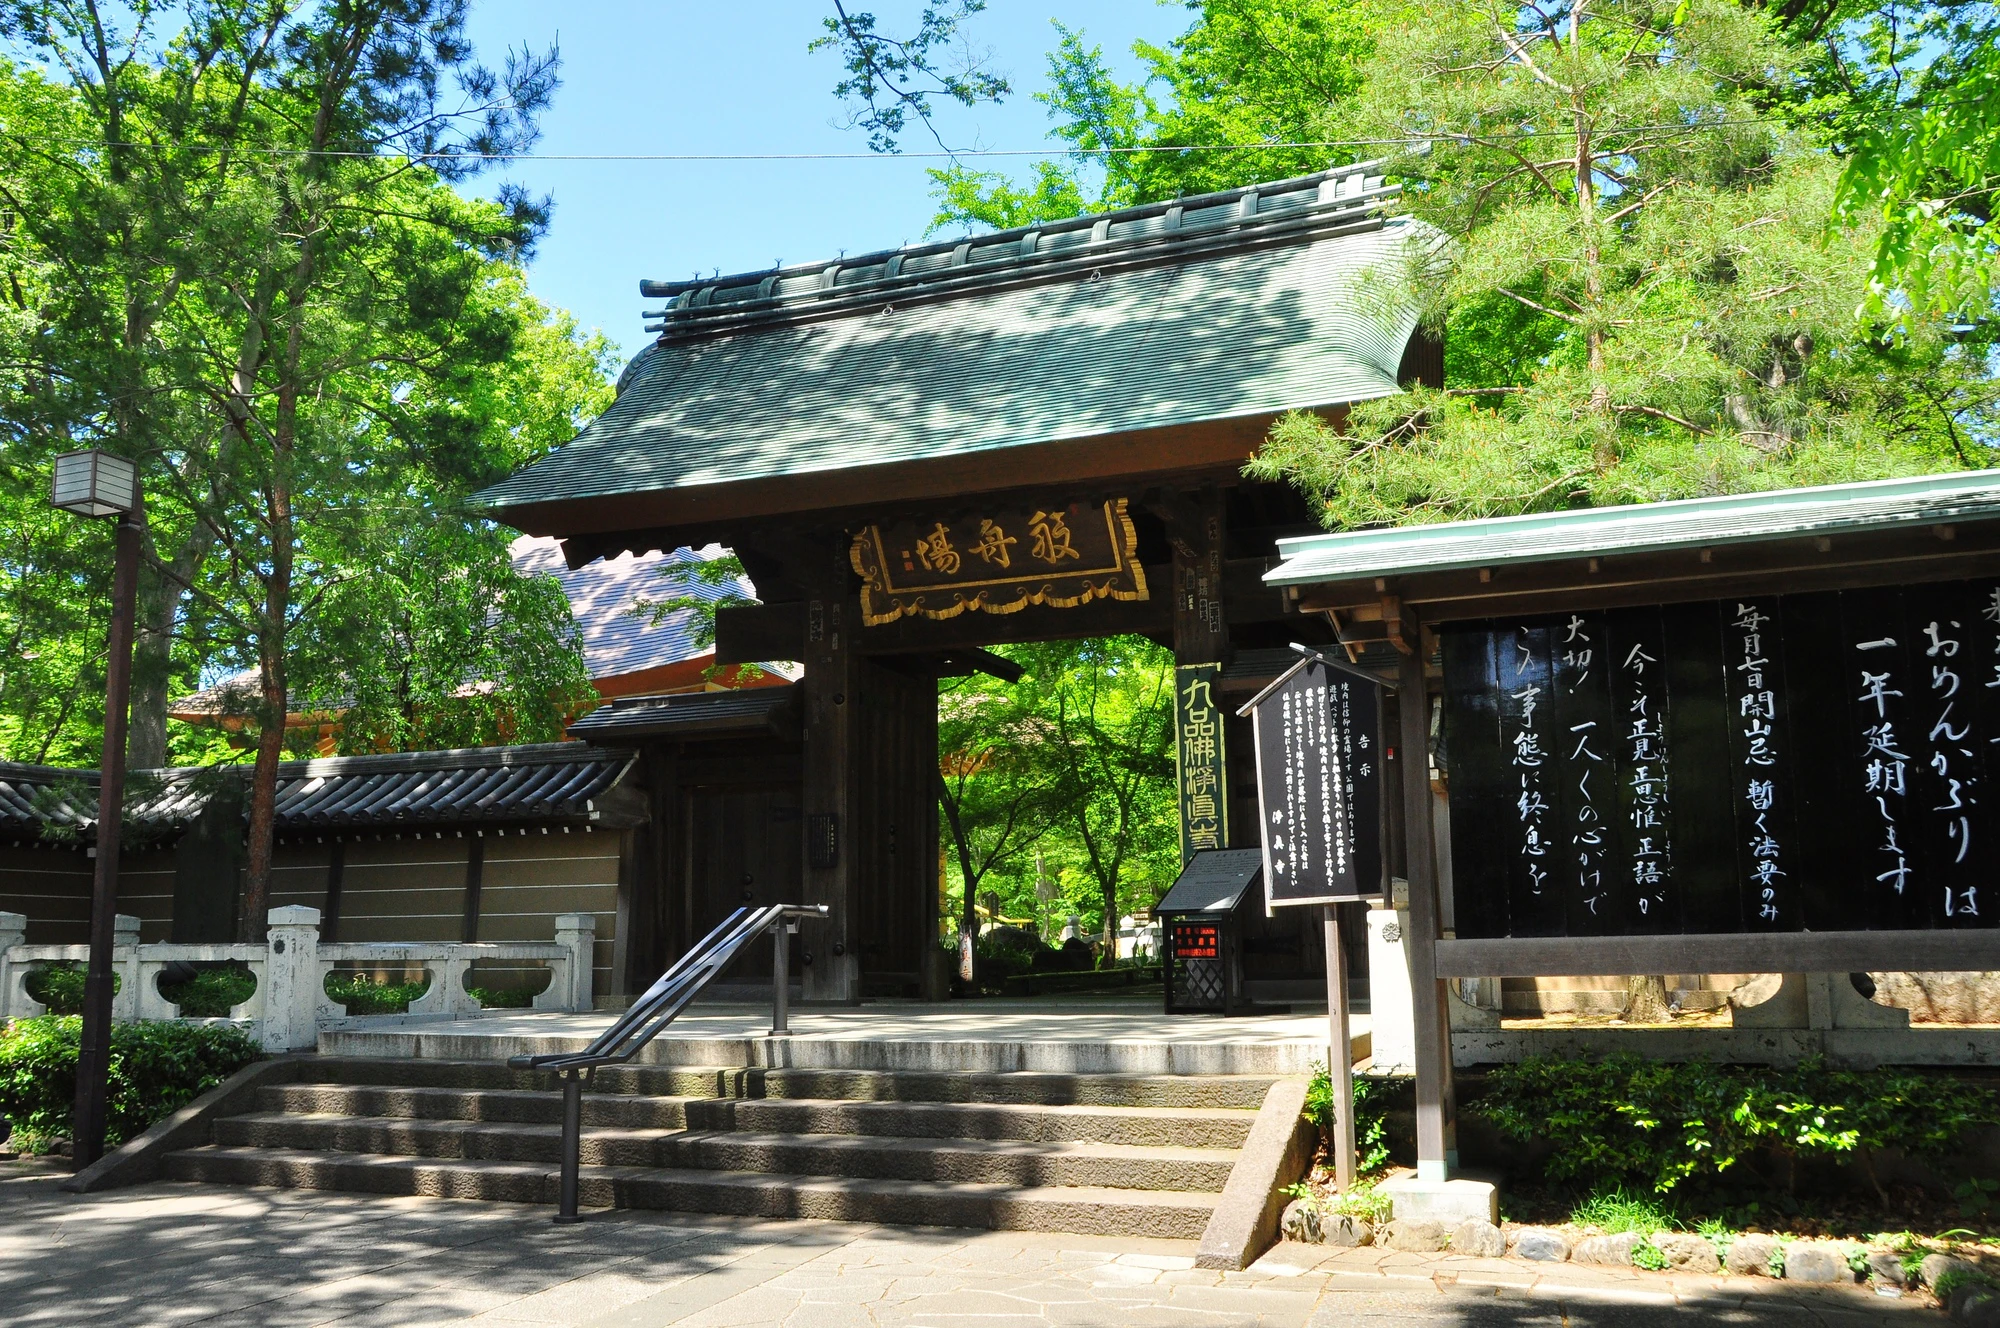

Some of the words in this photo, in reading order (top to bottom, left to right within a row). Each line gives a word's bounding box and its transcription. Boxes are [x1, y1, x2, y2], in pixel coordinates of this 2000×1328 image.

[1358, 734, 1371, 777] 告示
[1855, 637, 1912, 894] 一年延期します
